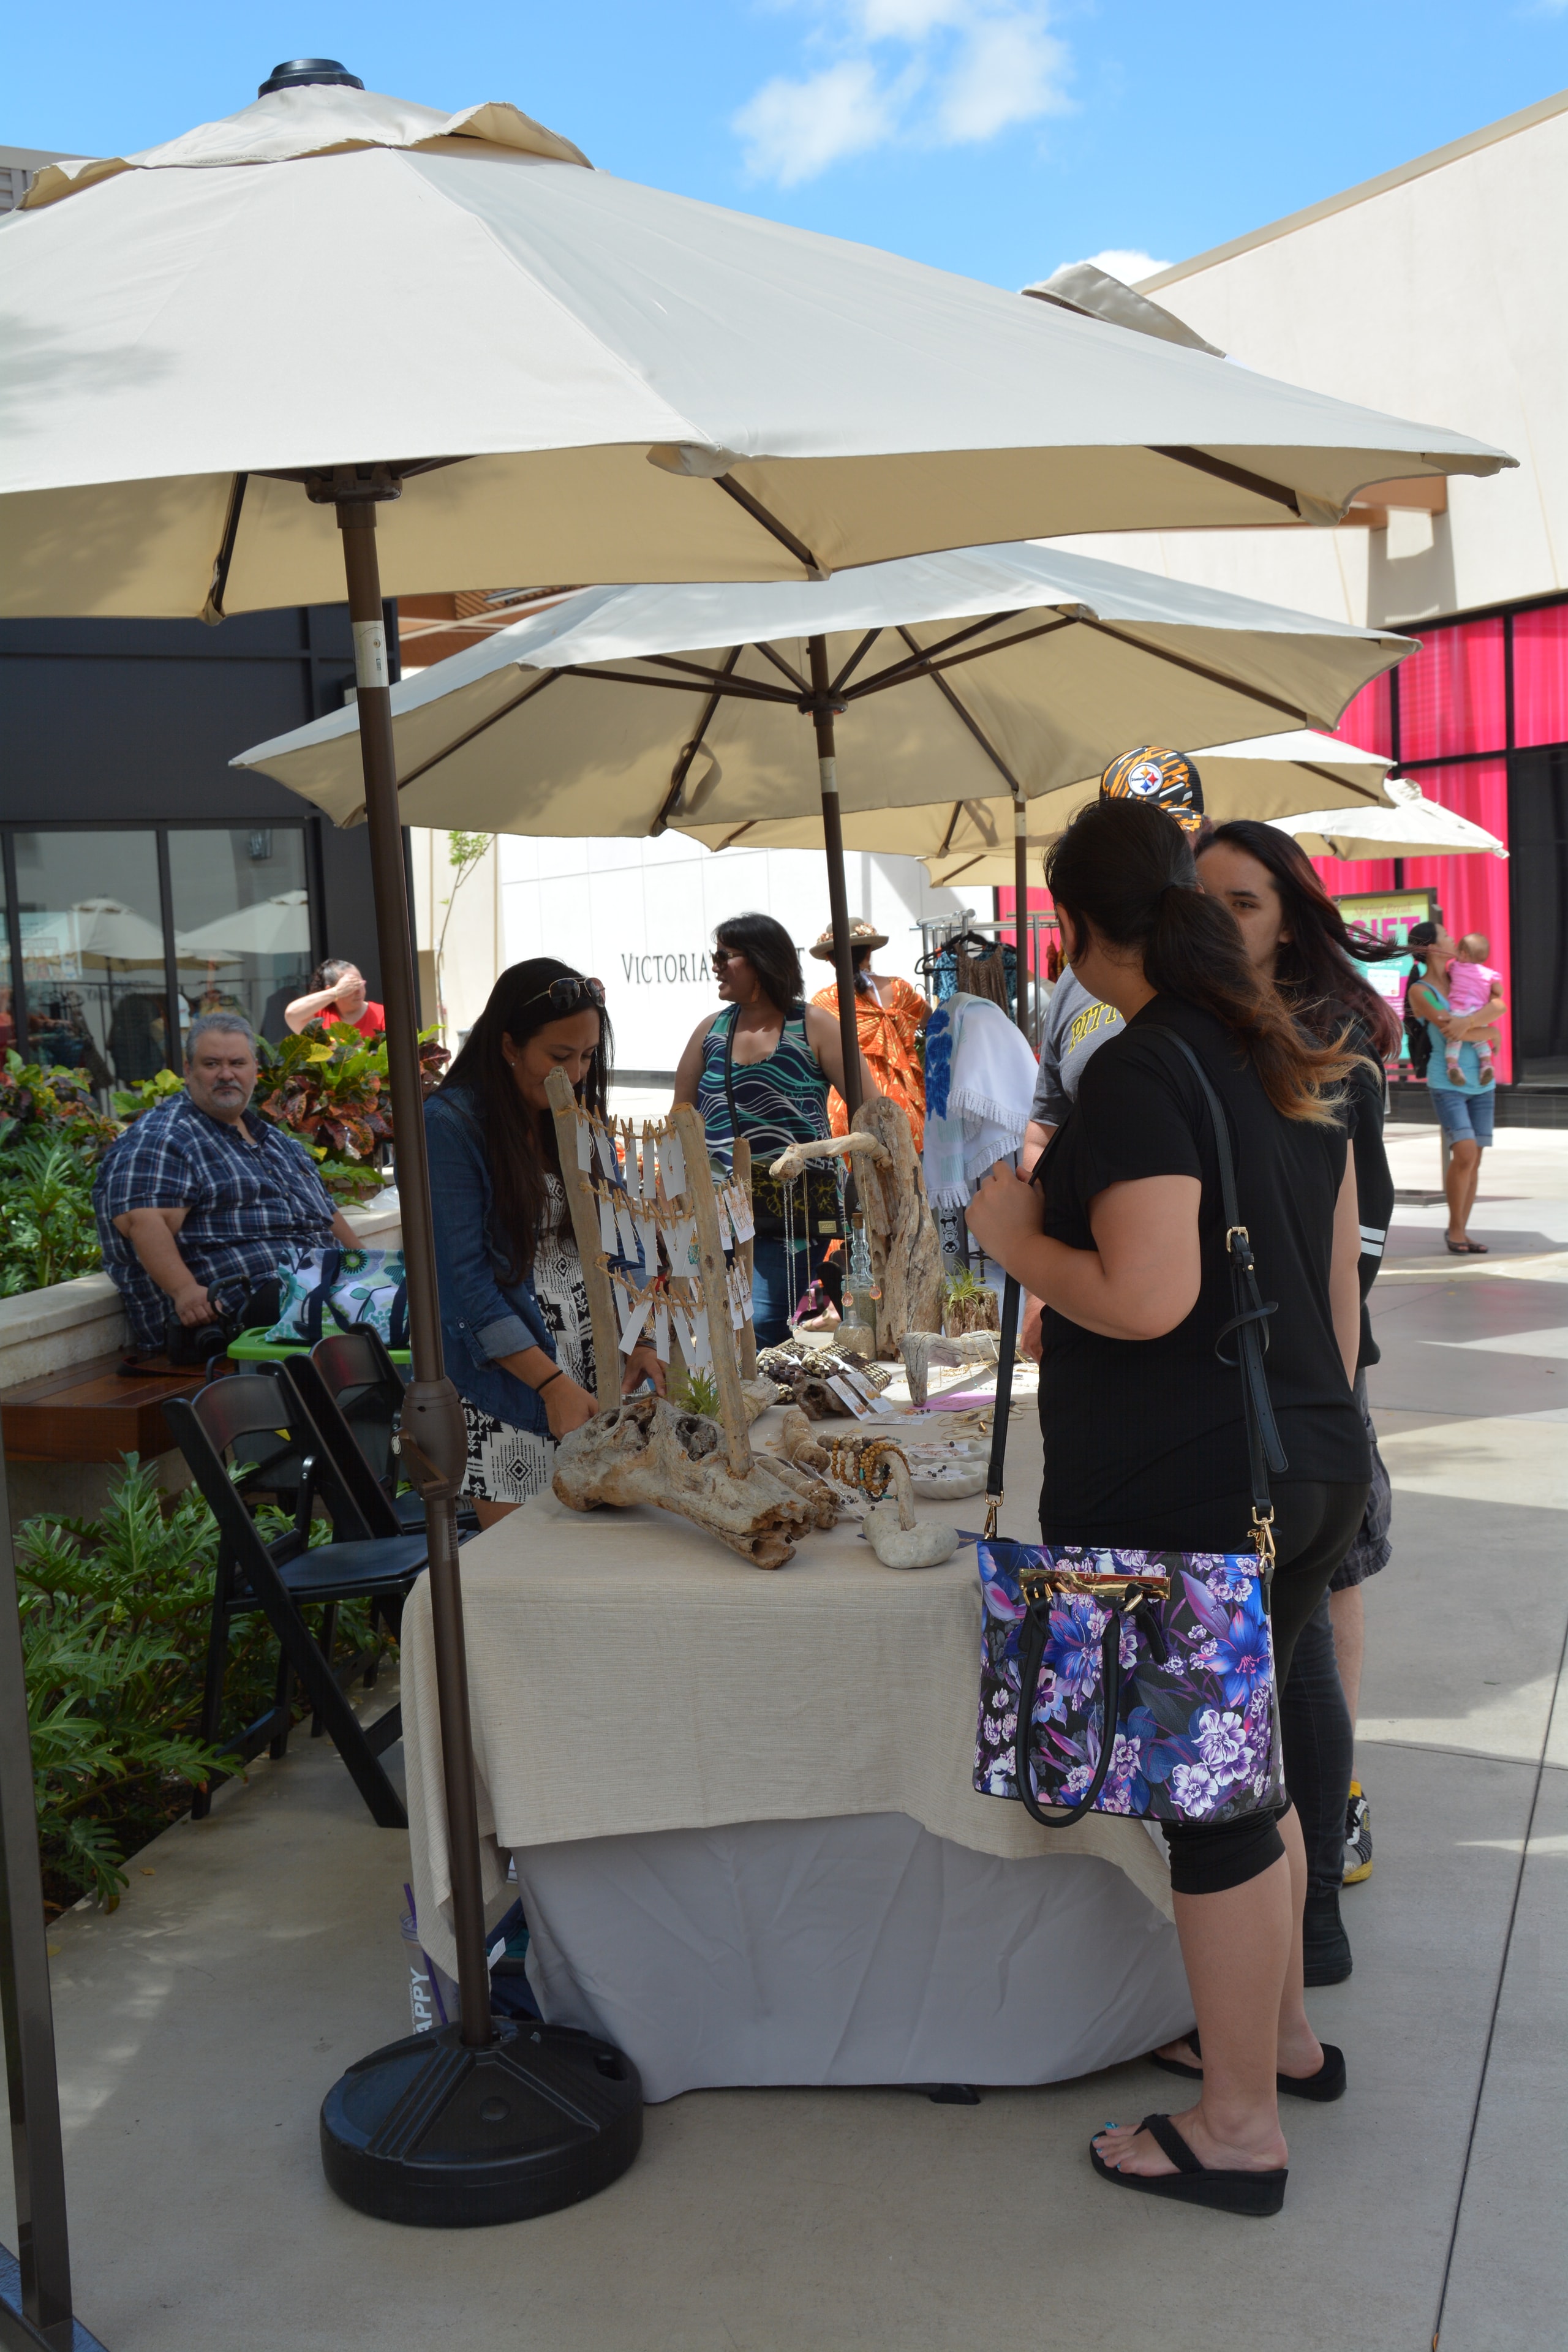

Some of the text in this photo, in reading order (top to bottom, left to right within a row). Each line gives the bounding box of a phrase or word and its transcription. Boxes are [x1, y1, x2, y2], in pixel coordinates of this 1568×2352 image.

[1348, 916, 1420, 946] GIFT
[1068, 1001, 1125, 1054] PITT
[410, 1966, 432, 2033] APPY
